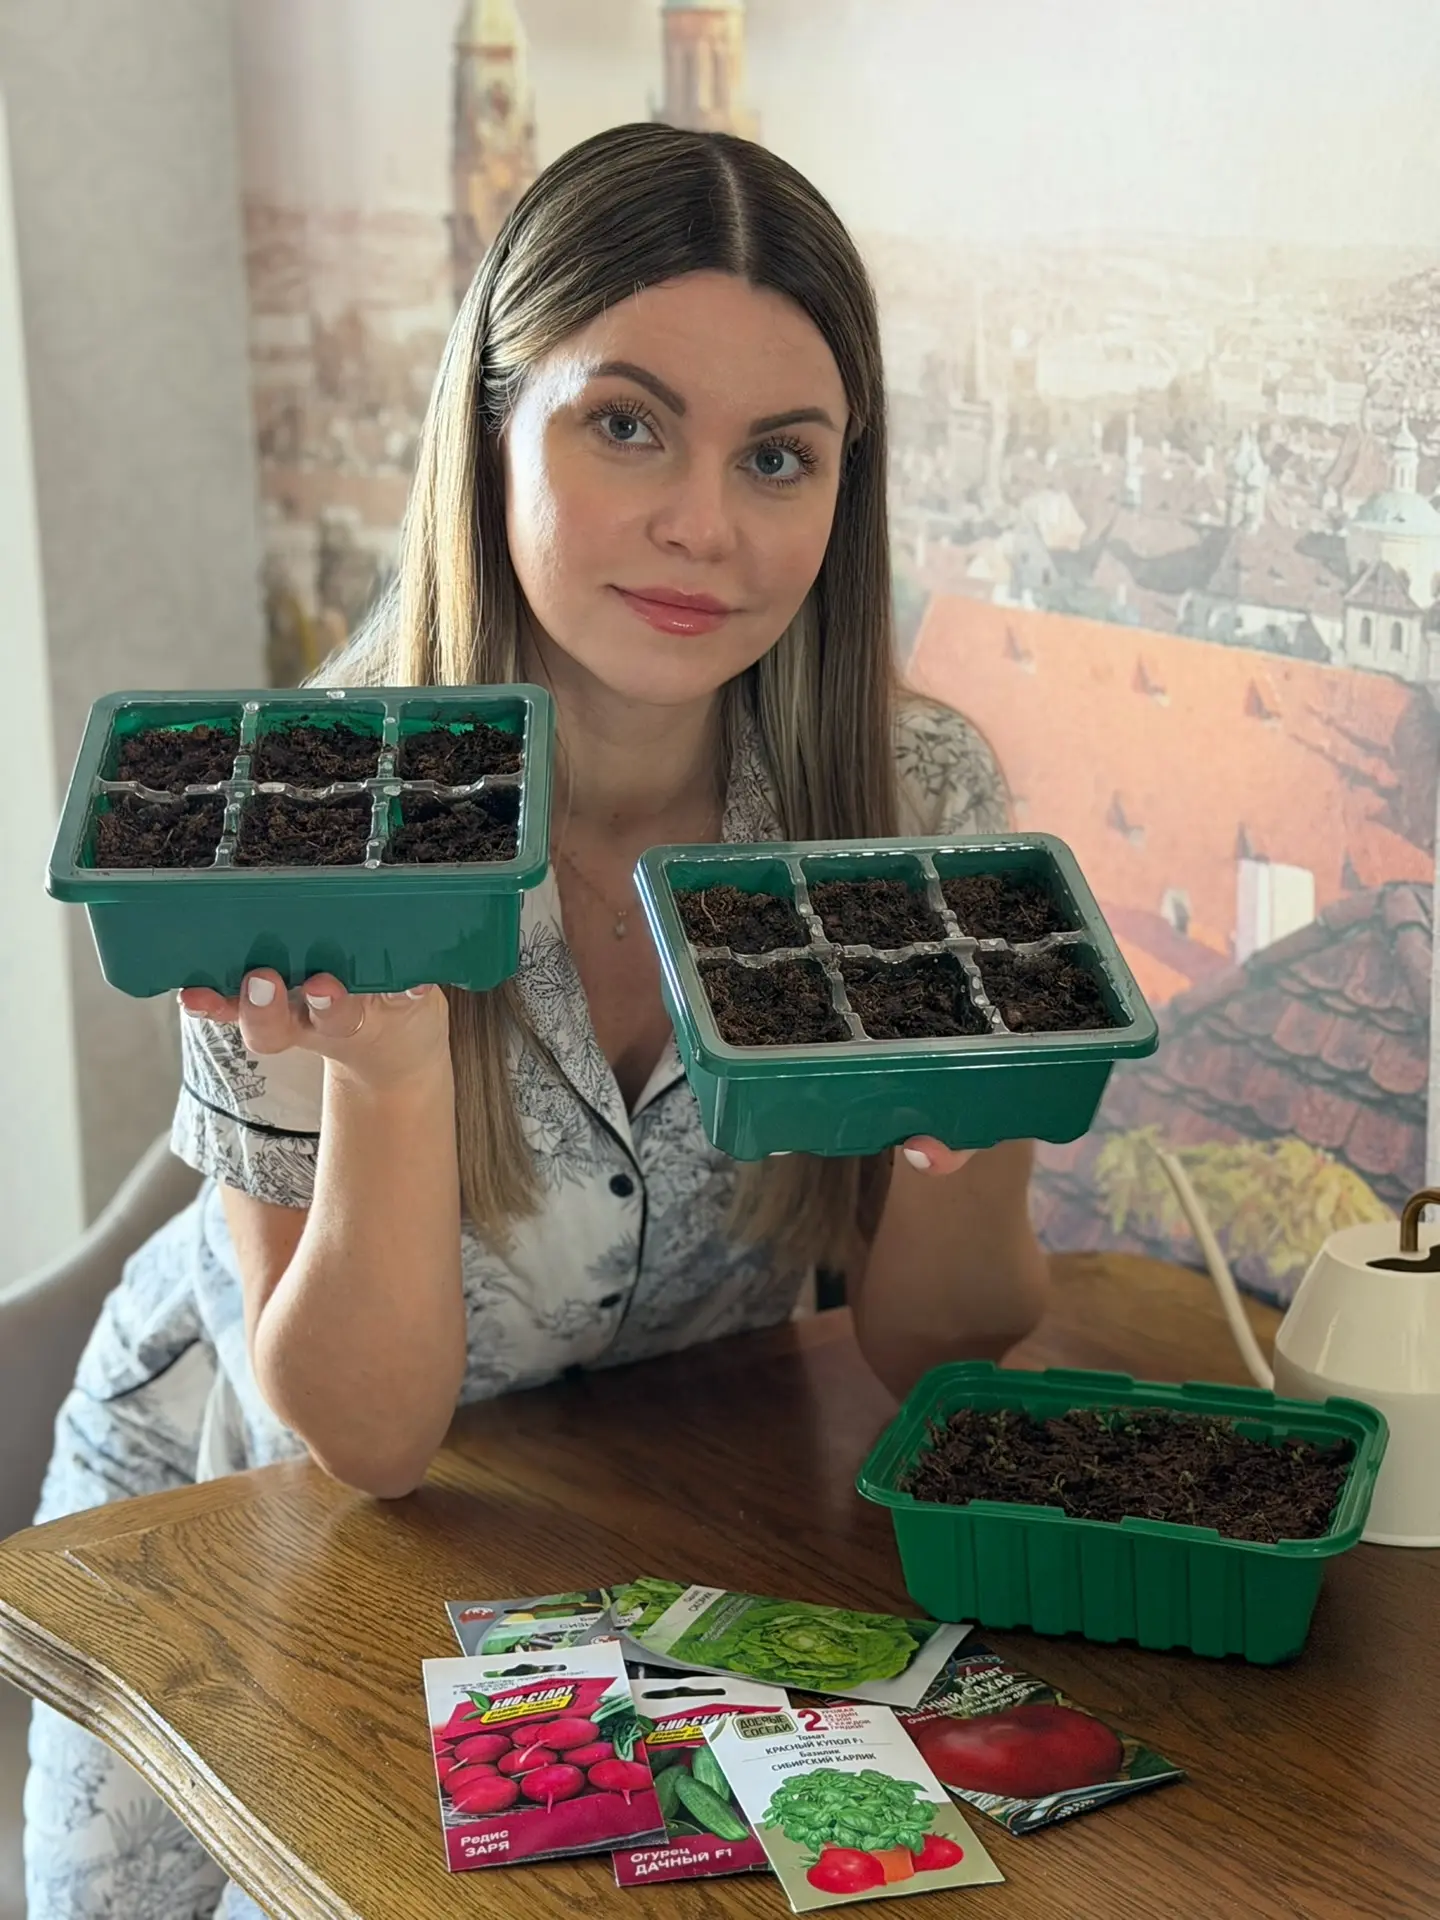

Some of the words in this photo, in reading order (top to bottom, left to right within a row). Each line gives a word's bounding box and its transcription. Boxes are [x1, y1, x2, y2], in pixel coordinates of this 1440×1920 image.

[953, 1666, 1004, 1687] Томат
[963, 1674, 1015, 1698] САХАР
[490, 1684, 576, 1710] БИО-СТАРТ
[797, 1708, 829, 1732] 2
[743, 1725, 792, 1738] СОСЕДИ
[765, 1741, 815, 1755] КРАСНЫЙ
[816, 1738, 851, 1749] КУПОЛ
[799, 1748, 841, 1758] Базилик
[771, 1756, 834, 1772] СИБИРСКИЙ
[835, 1753, 877, 1763] КАРЛИК
[460, 1829, 509, 1847] Редис
[465, 1840, 510, 1858] ЗАРЯ
[630, 1847, 690, 1863] Огурец
[635, 1851, 709, 1877] ДАЧНЫЙ
[715, 1847, 732, 1859] F1
